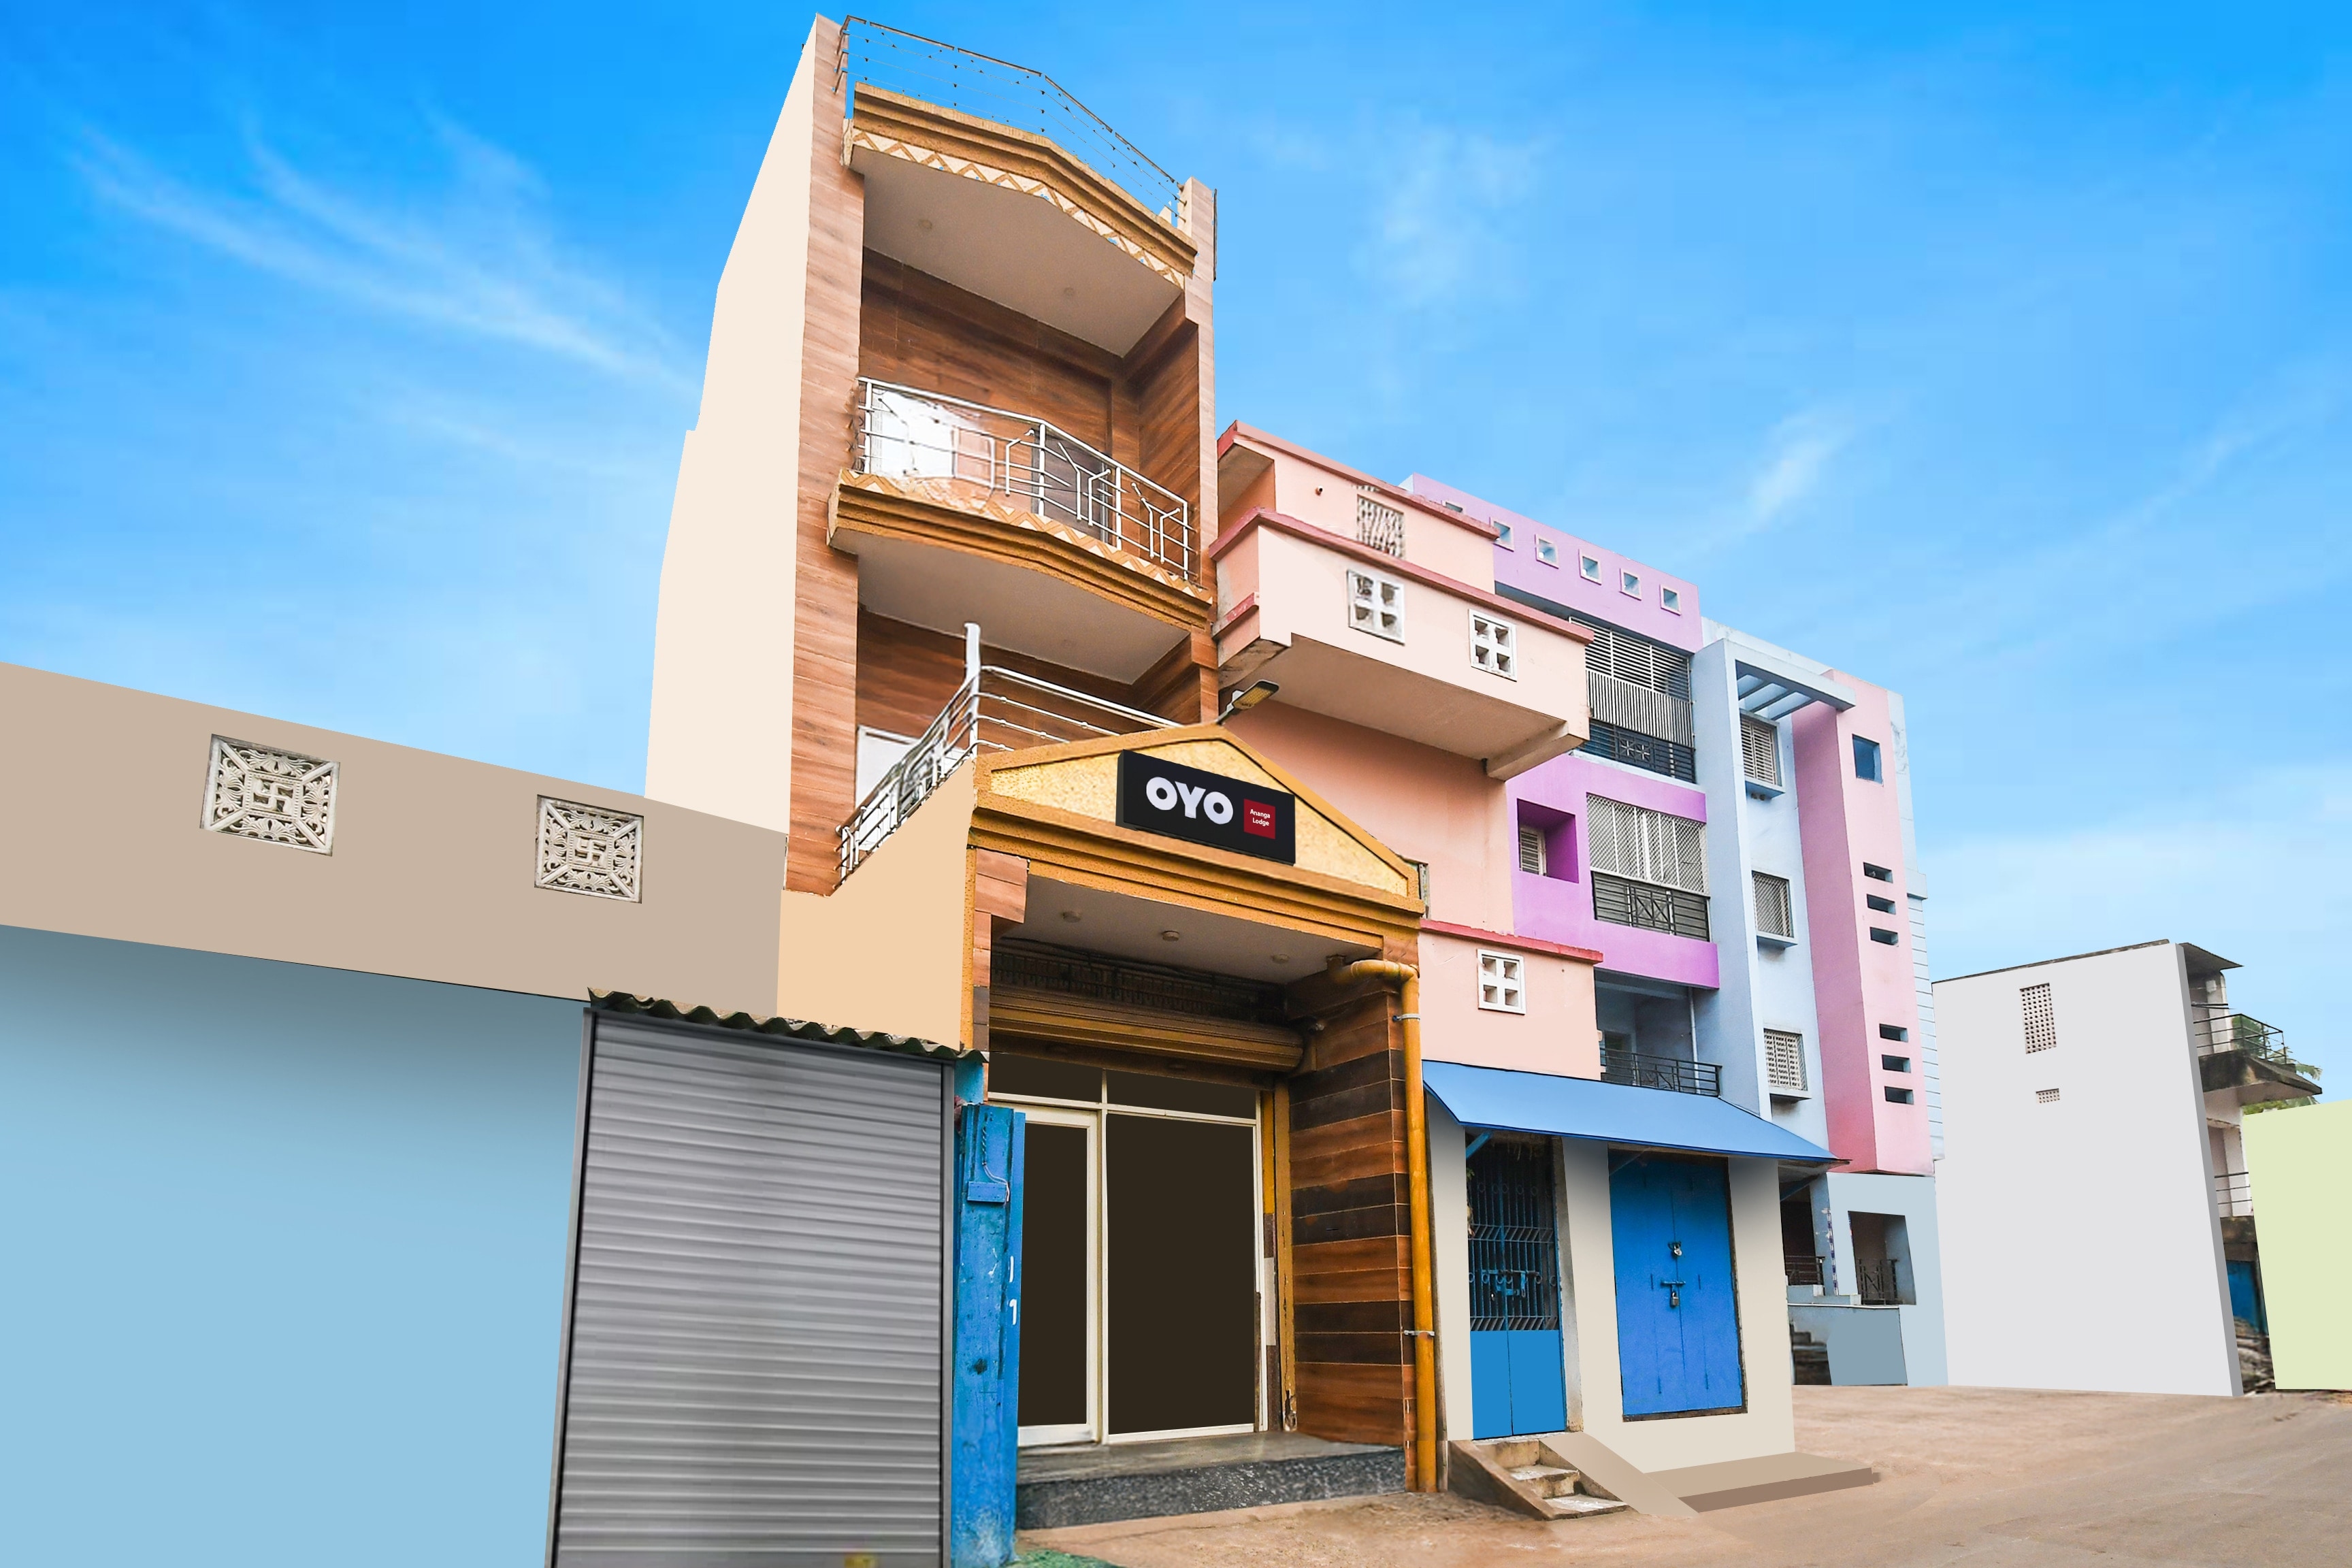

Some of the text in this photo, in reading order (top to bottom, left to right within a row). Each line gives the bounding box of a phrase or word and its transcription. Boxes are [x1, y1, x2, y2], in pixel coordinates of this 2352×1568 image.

[1146, 777, 1233, 824] OYO
[1250, 809, 1271, 819] Ananga
[1253, 817, 1269, 826] Lodge
